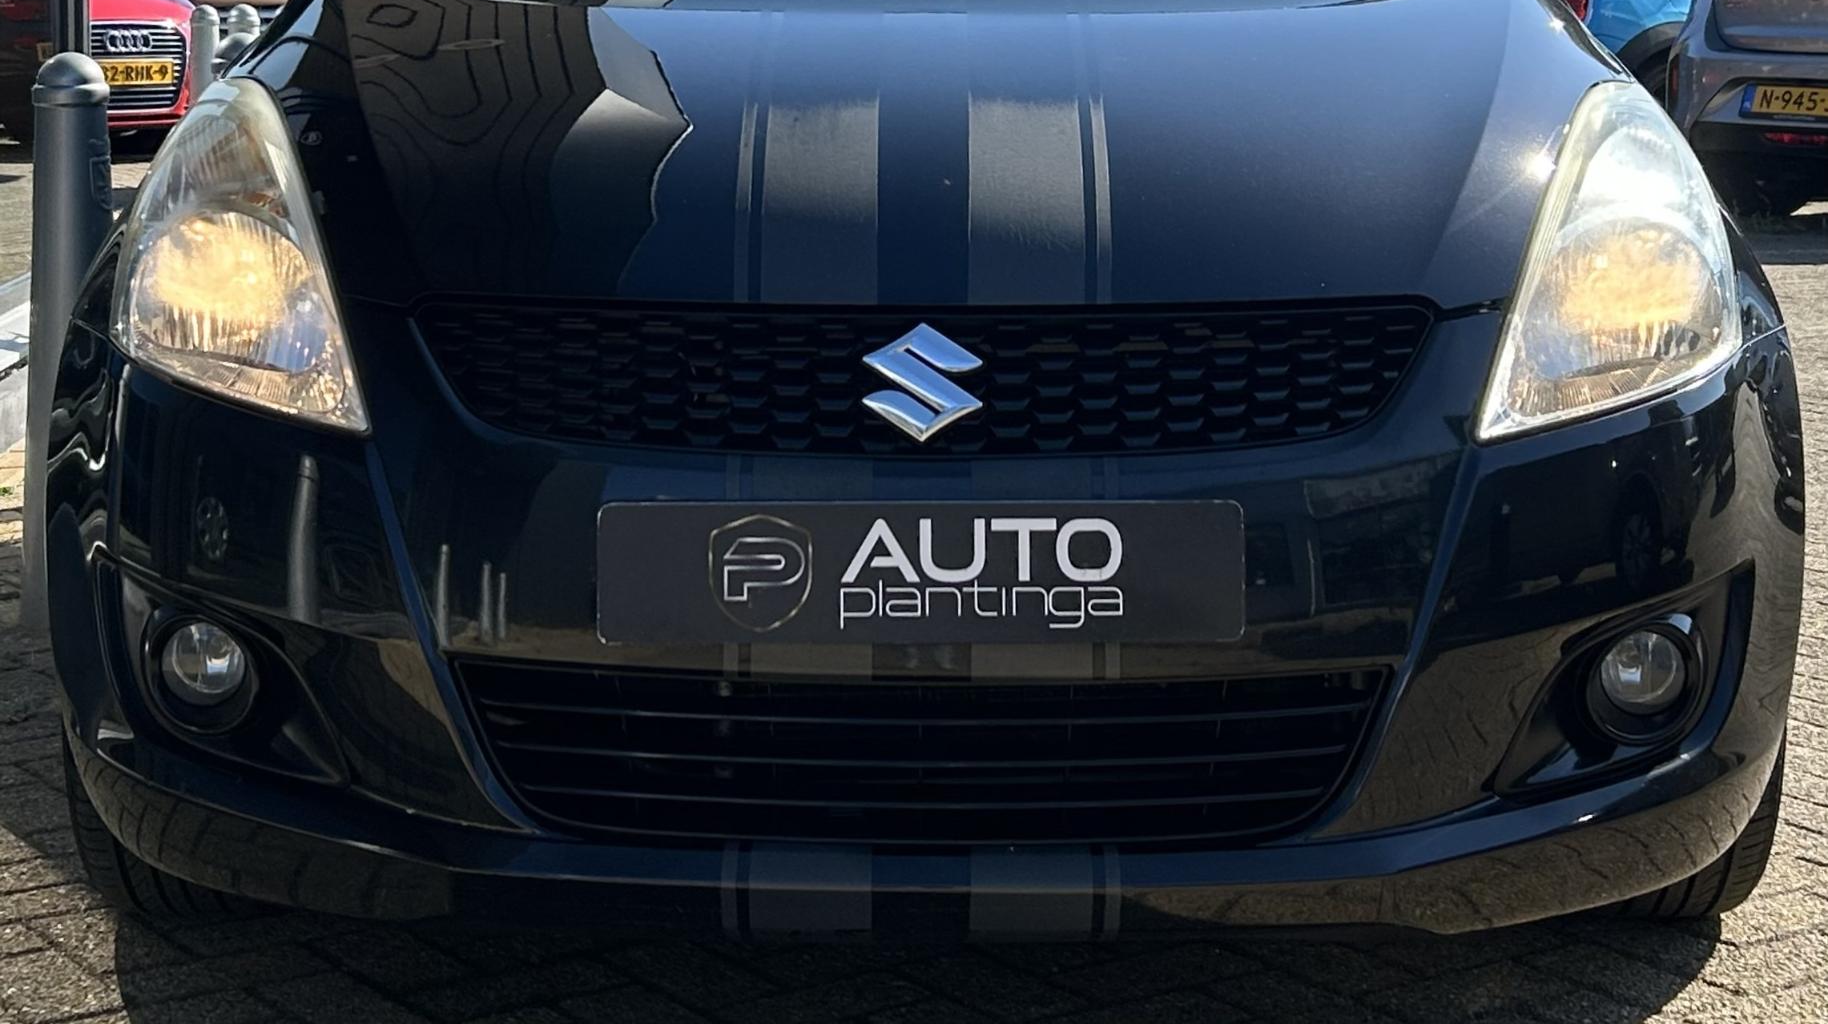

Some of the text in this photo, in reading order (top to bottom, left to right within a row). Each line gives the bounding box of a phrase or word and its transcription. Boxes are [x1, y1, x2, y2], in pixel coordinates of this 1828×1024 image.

[1759, 89, 1828, 112] N-945-
[841, 517, 1123, 583] AUTO
[840, 579, 1123, 630] plantinga
